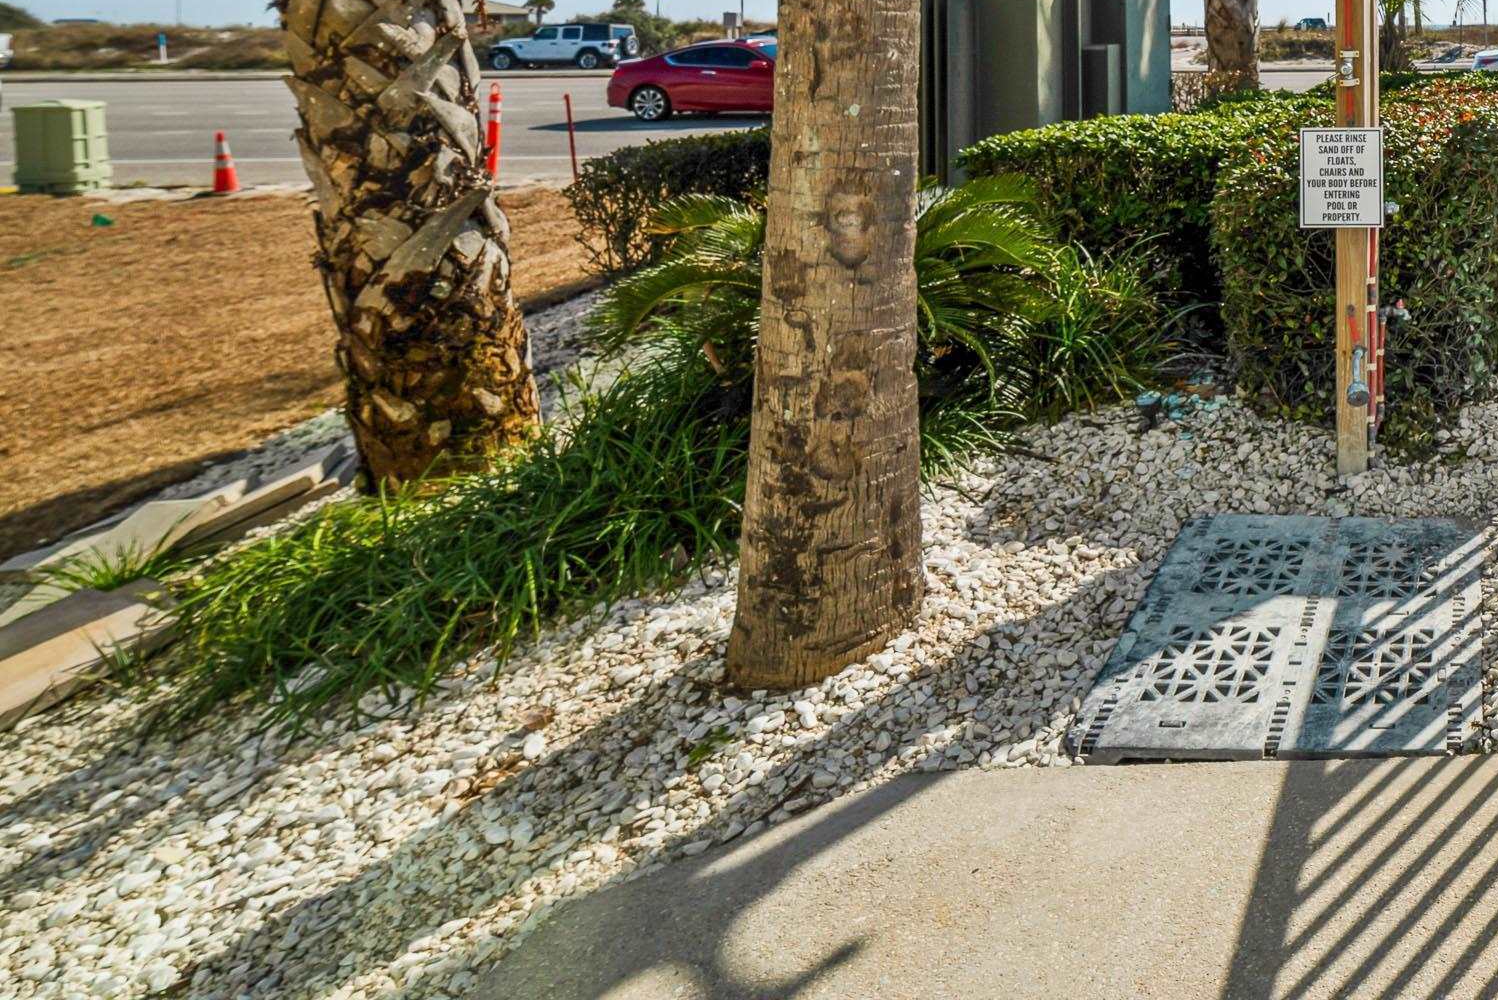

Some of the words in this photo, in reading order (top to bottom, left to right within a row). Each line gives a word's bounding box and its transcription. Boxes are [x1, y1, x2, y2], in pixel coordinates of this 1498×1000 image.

[1316, 134, 1342, 143] PLEASE
[1345, 134, 1367, 143] RINSE
[1318, 145, 1339, 154] SAND
[1340, 145, 1354, 154] OFF
[1355, 145, 1365, 154] OF
[1327, 156, 1357, 166] FLOATS,
[1319, 168, 1347, 176] CHAIRS
[1348, 168, 1365, 176] AND
[1307, 179, 1327, 187] YOUR
[1328, 179, 1348, 187] BODY
[1349, 179, 1377, 187] BEFORE
[1324, 190, 1360, 199] ENTERING
[1326, 202, 1345, 210] POOL
[1347, 202, 1358, 210] OR
